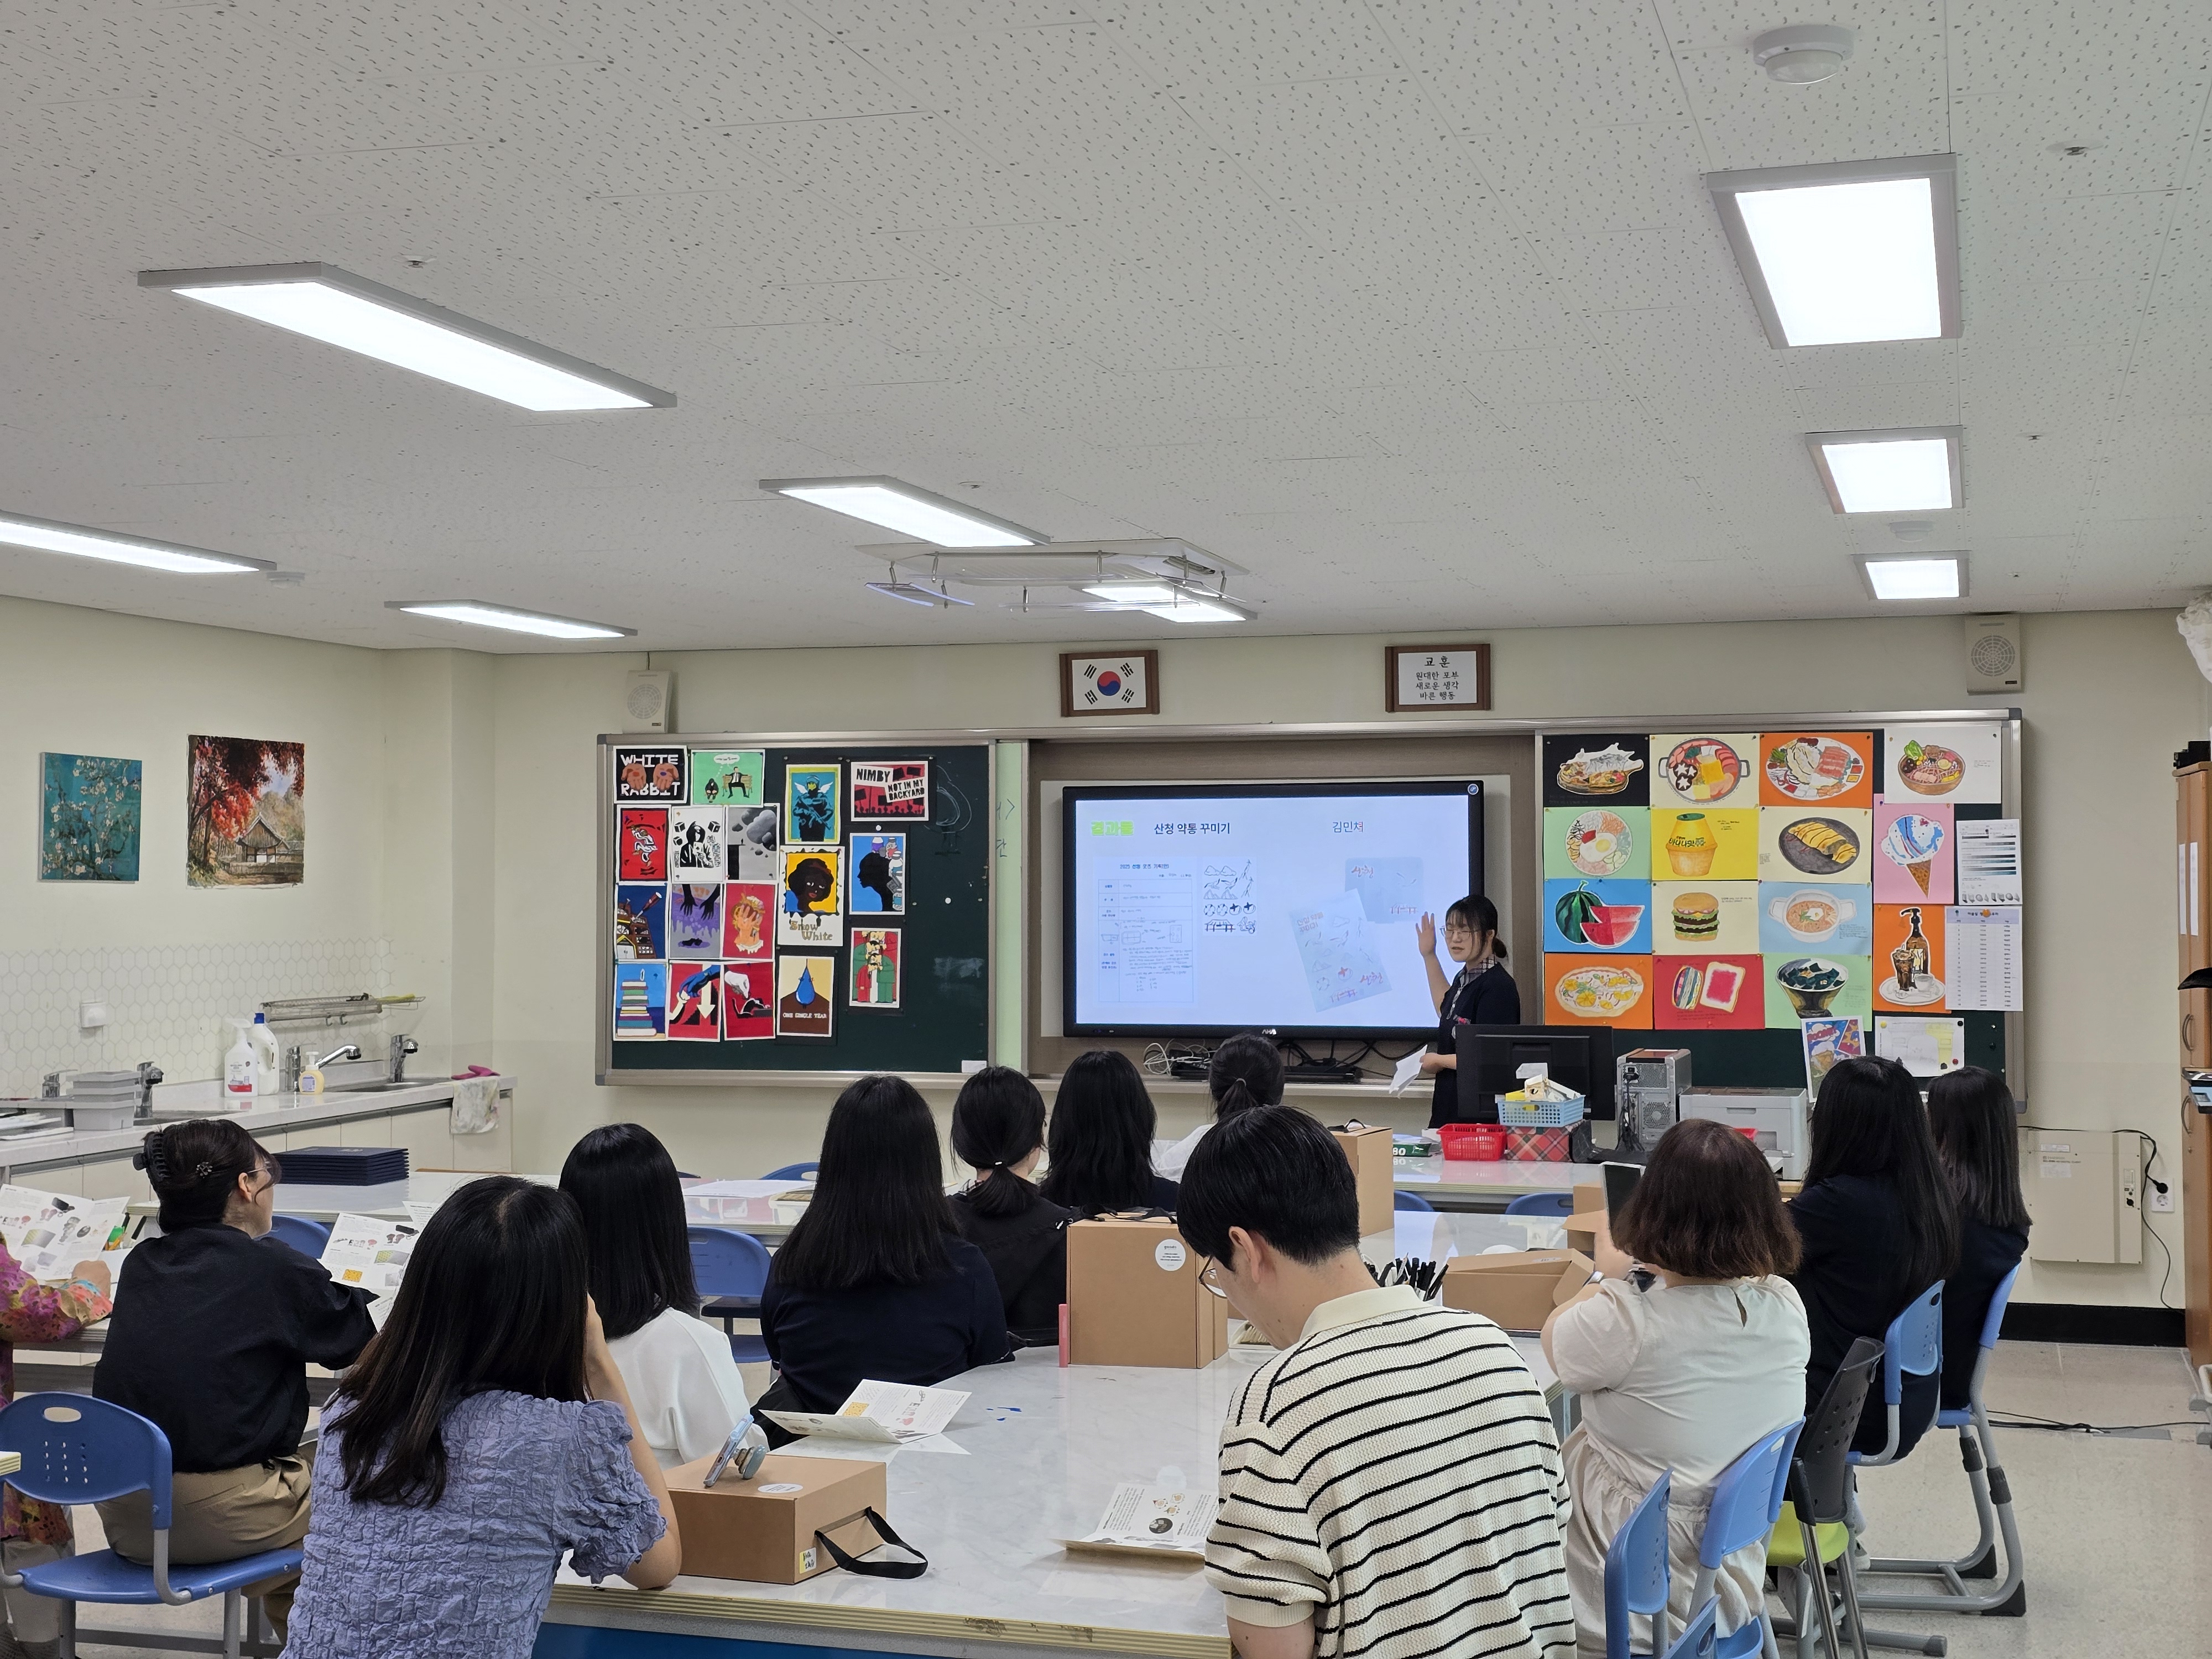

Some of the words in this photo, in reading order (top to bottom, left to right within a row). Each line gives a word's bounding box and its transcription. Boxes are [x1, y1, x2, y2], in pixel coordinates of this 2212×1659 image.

[1416, 671, 1439, 681] 원대한
[1442, 671, 1459, 680] 포부
[1416, 681, 1440, 691] 새로운
[1443, 680, 1459, 690] 생각
[1420, 691, 1436, 701] 바른
[1439, 691, 1455, 701] 행동
[620, 754, 679, 768] WHITE
[856, 768, 891, 783] NIMBY
[888, 782, 902, 792] NOT
[903, 781, 911, 790] IN
[913, 779, 924, 787] MY
[888, 787, 925, 801] BACKYARD
[1154, 822, 1174, 834] 산청
[1177, 822, 1197, 834] 약통
[1199, 822, 1230, 834] 꾸미기
[789, 920, 818, 931] Snow
[802, 931, 833, 941] White
